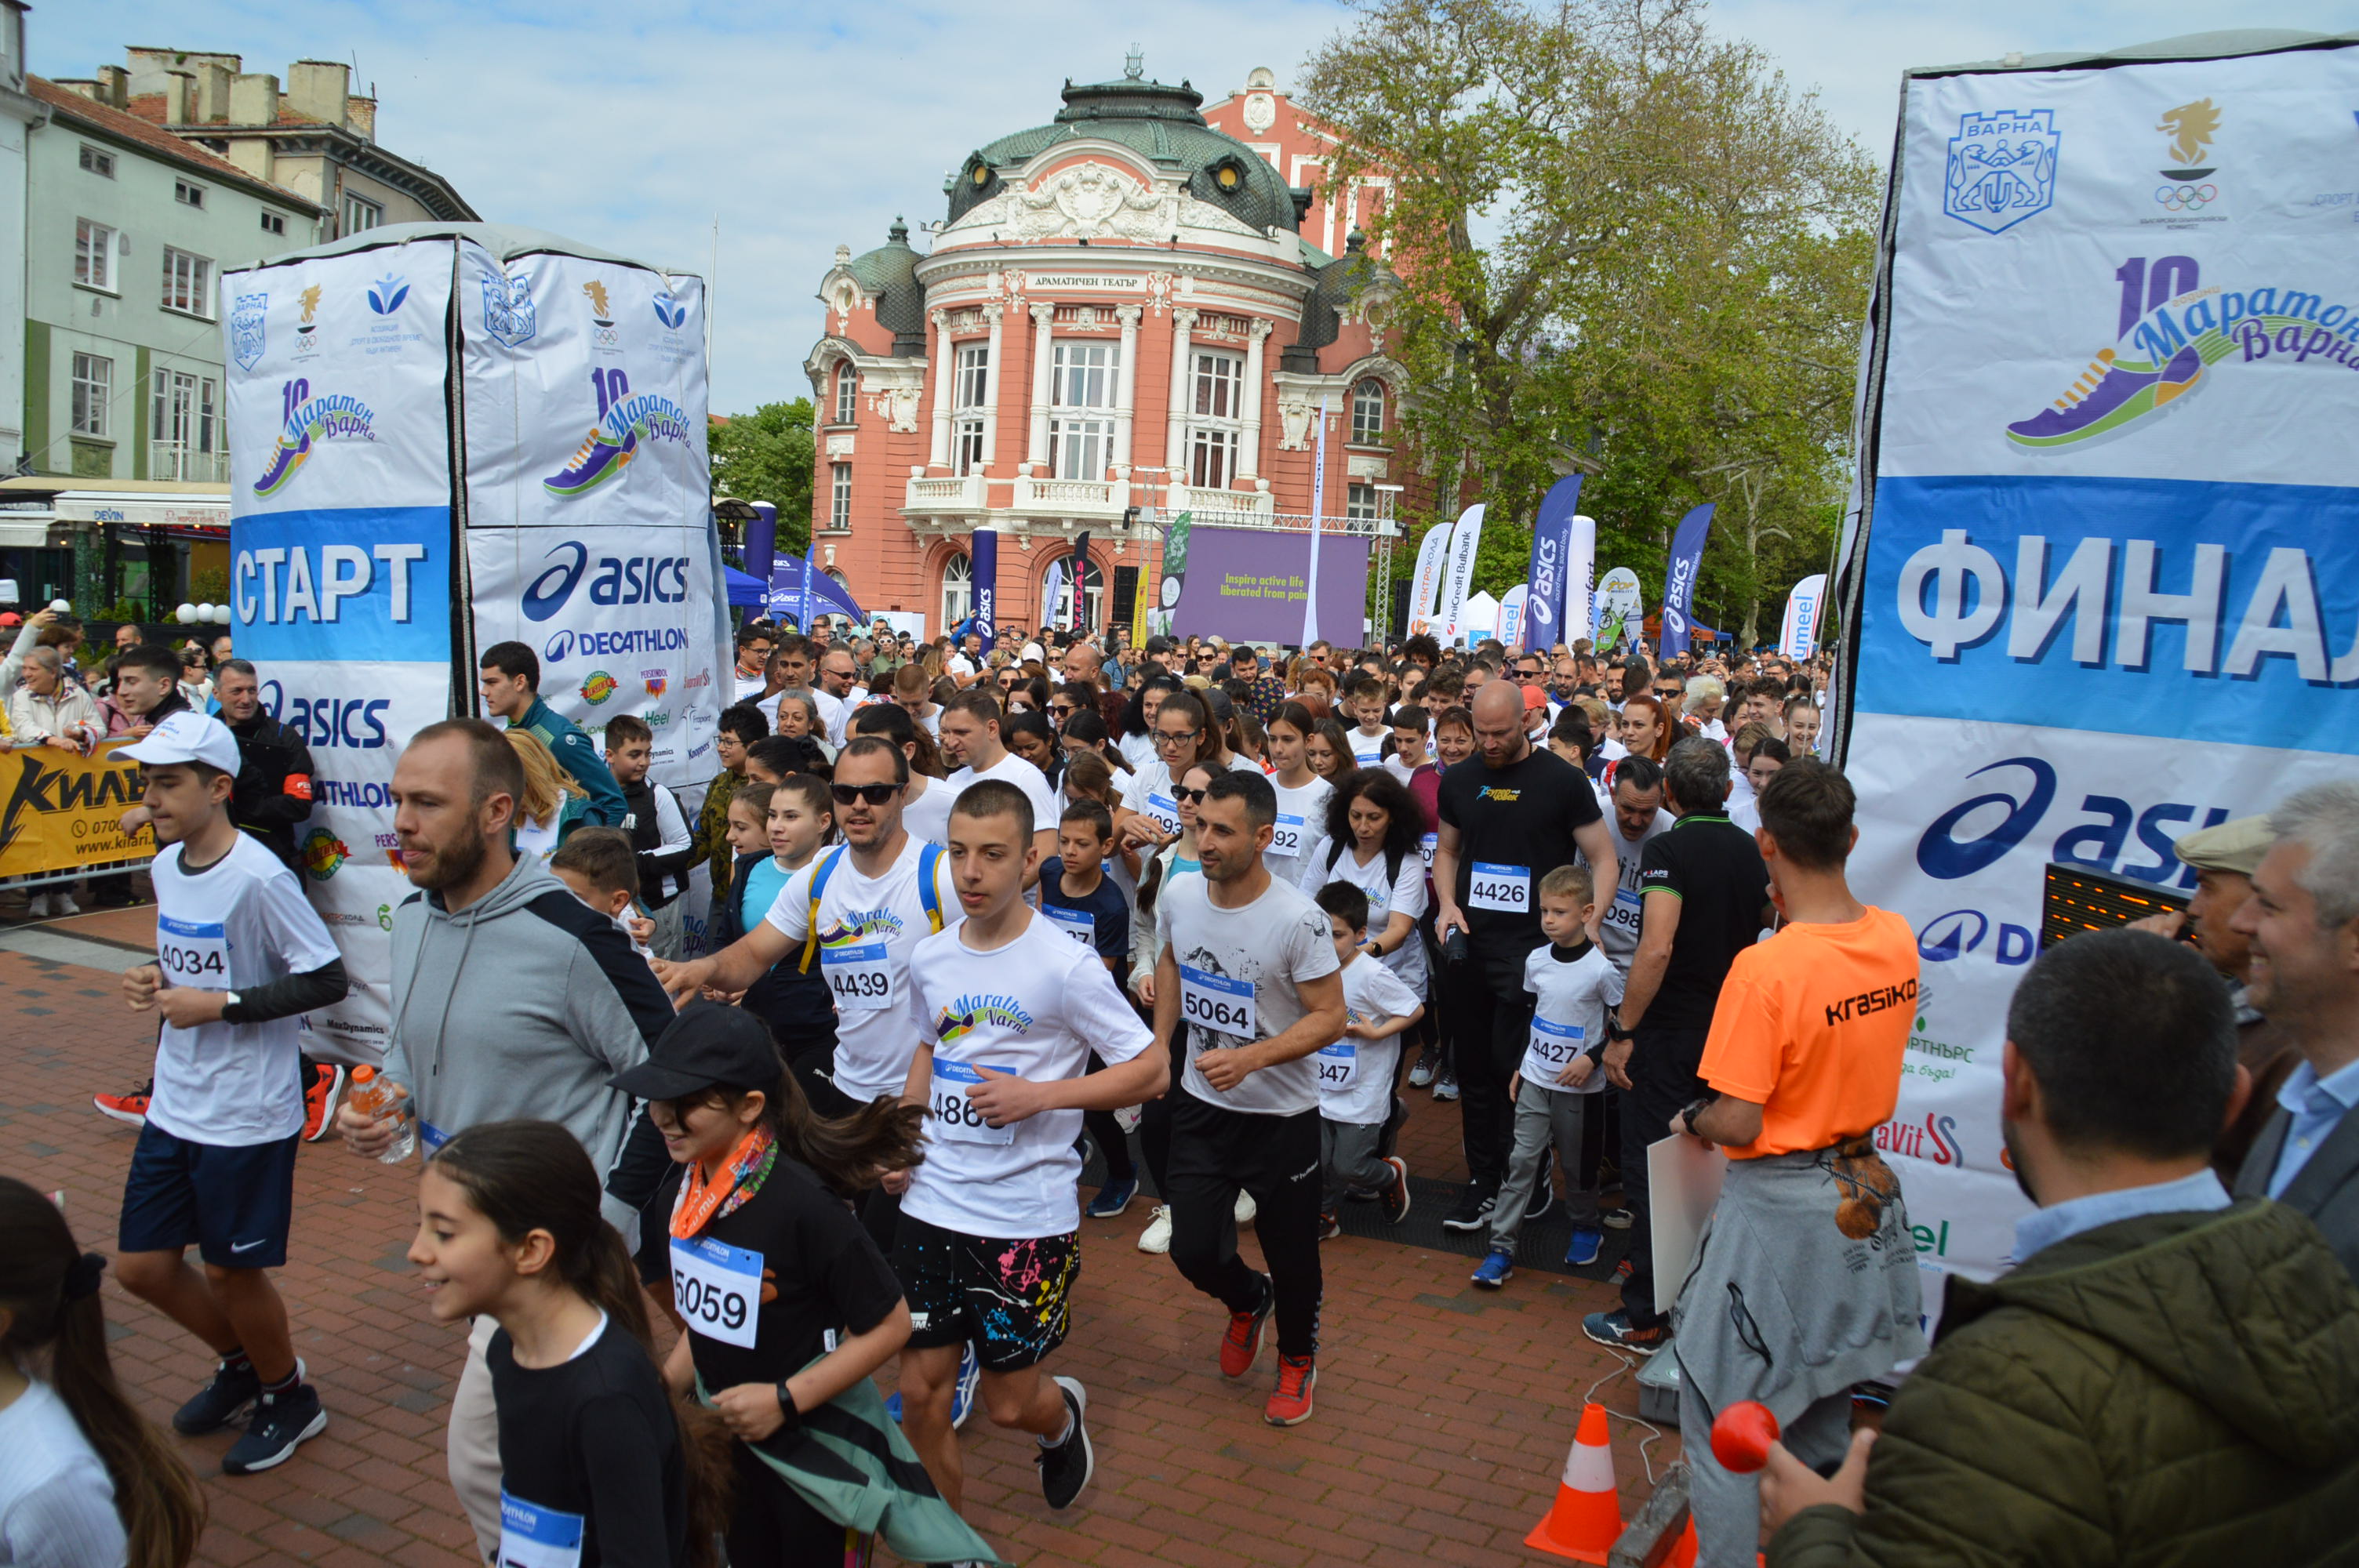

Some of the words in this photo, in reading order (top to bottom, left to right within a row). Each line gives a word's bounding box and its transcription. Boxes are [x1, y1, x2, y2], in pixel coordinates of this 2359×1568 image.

[1967, 121, 2043, 137] ВАРНА
[1035, 277, 1099, 286] ДРАМАТИЧЕН
[1102, 278, 1138, 287] ТЕАТЪР
[2116, 255, 2200, 344] 10
[282, 378, 309, 430] 10
[591, 367, 630, 425] 10
[287, 394, 374, 443] Маратон
[322, 413, 376, 441] Варна
[607, 394, 691, 442] Маратон
[645, 413, 692, 448] Варна
[94, 508, 124, 521] DEVIN
[1456, 531, 1471, 573] Bulbank
[236, 543, 427, 624] СТАРТ
[1220, 584, 1262, 597] liberated
[1263, 586, 1286, 599] from
[1289, 590, 1308, 602] pain
[1225, 572, 1257, 586] Inspire
[1259, 575, 1287, 586] active
[1289, 575, 1304, 587] life
[801, 561, 812, 636] ECATHLON
[1451, 573, 1463, 622] UniCredit
[1896, 528, 2359, 684] ФИНА
[1503, 603, 1519, 647] meel
[1794, 595, 1814, 659] umeel
[579, 627, 689, 656] DECATHLON
[640, 669, 669, 679] PERSKINDOL
[688, 741, 711, 760] Knoppers
[314, 780, 392, 808] ATHLO
[1270, 830, 1298, 848] 92
[1473, 881, 1525, 903] 4426
[871, 920, 901, 937] Varna
[1605, 905, 1641, 928] 098
[162, 943, 224, 975] 4034
[834, 972, 889, 997] 4439
[954, 993, 1033, 1027] Marathon
[985, 1008, 1027, 1036] Varna
[1185, 991, 1249, 1029] 5064
[326, 1018, 385, 1034] MaxDynamics
[1532, 1037, 1578, 1064] 4427
[1876, 1121, 1925, 1159] aVit
[1911, 1220, 1950, 1257] el
[1918, 1262, 1943, 1274] ature
[674, 1269, 747, 1330] 5059
